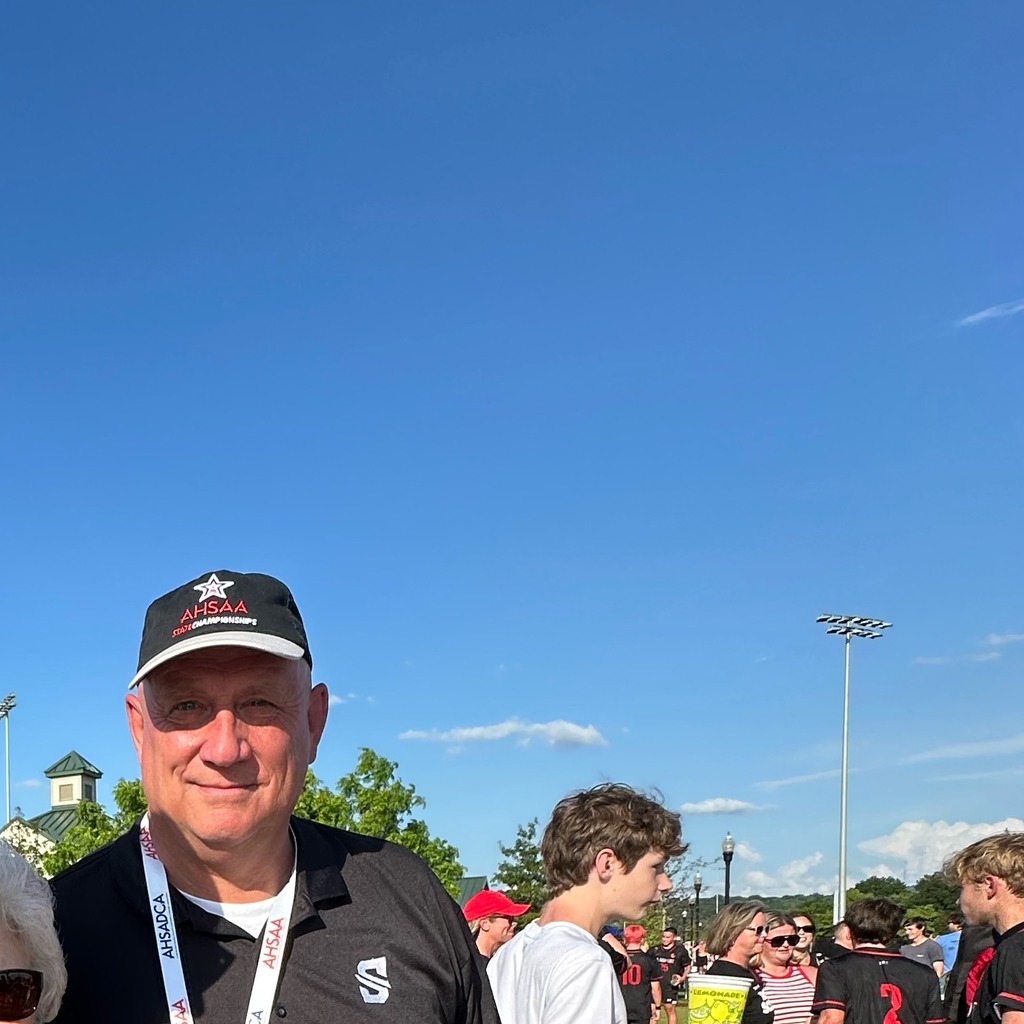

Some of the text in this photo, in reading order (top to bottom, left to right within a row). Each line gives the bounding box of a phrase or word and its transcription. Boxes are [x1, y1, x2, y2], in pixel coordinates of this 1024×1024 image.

[180, 600, 248, 624] AHSAA
[152, 893, 176, 959] AHSADCA
[262, 917, 286, 970] AHSAA
[693, 989, 741, 999] LEMONADE
